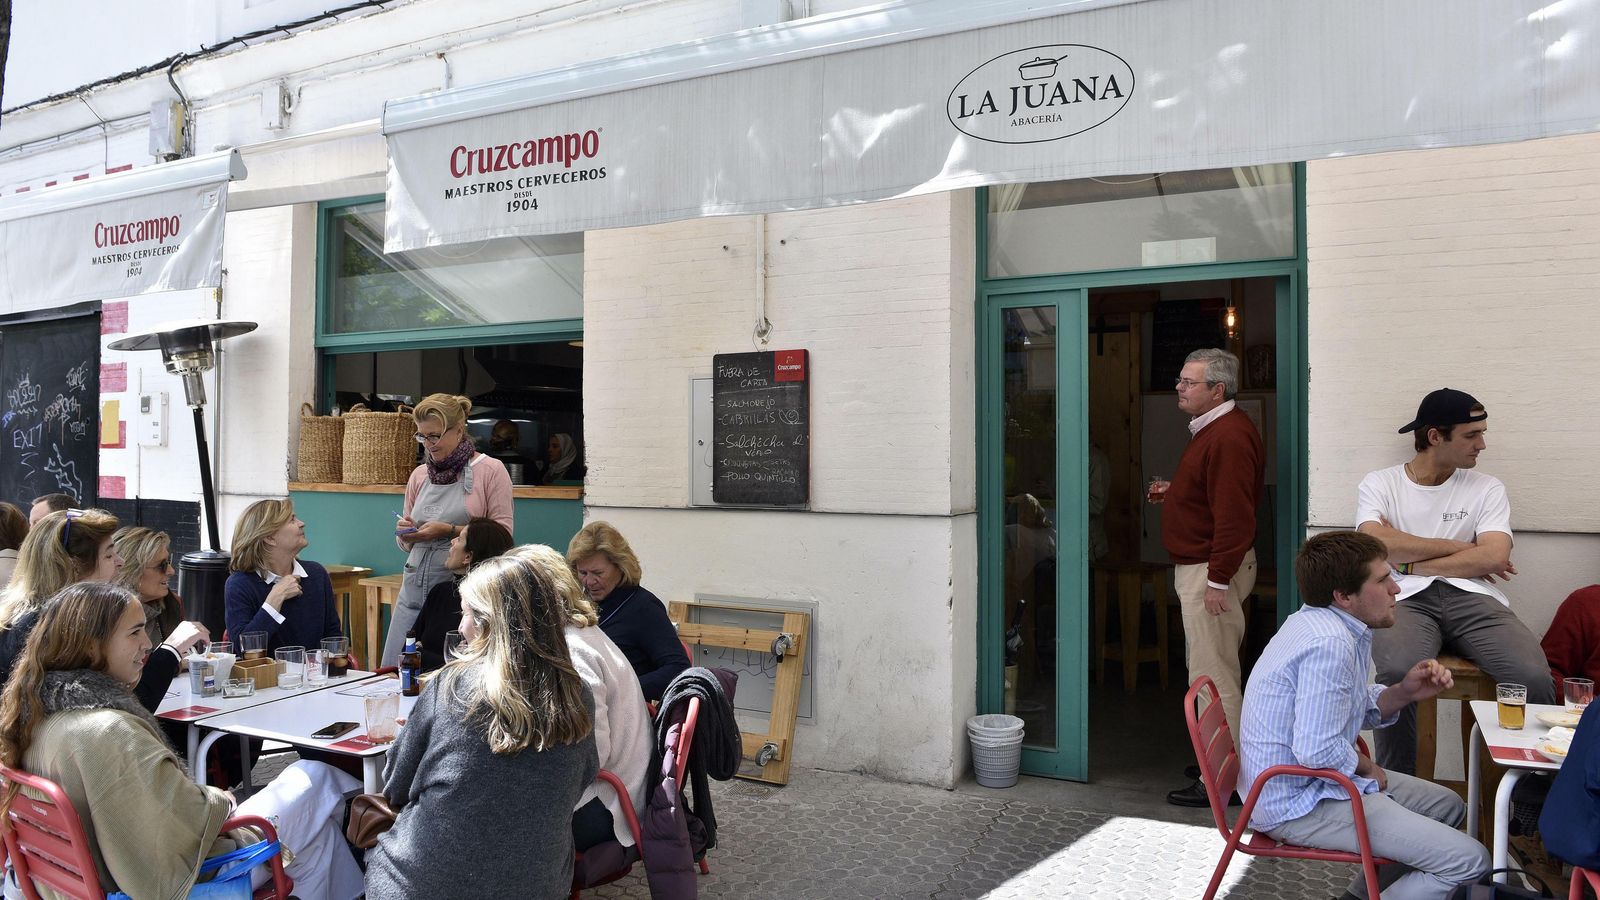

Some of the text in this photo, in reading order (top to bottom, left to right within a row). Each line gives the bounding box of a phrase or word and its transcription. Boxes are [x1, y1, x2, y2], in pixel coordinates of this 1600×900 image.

[957, 74, 1124, 119] LA JUANA
[1010, 113, 1063, 127] ABACERÍA
[450, 129, 600, 179] Cruzcampo
[444, 167, 607, 199] MAESTROS CERVECEROS
[513, 190, 533, 199] DESDE
[507, 199, 539, 212] 1904
[94, 215, 180, 248] Cruzcampo
[91, 244, 181, 265] MAESTROS CERVECEROS
[126, 267, 142, 278] 1904
[717, 366, 760, 378] FUERA DE
[13, 423, 43, 449] EXIT
